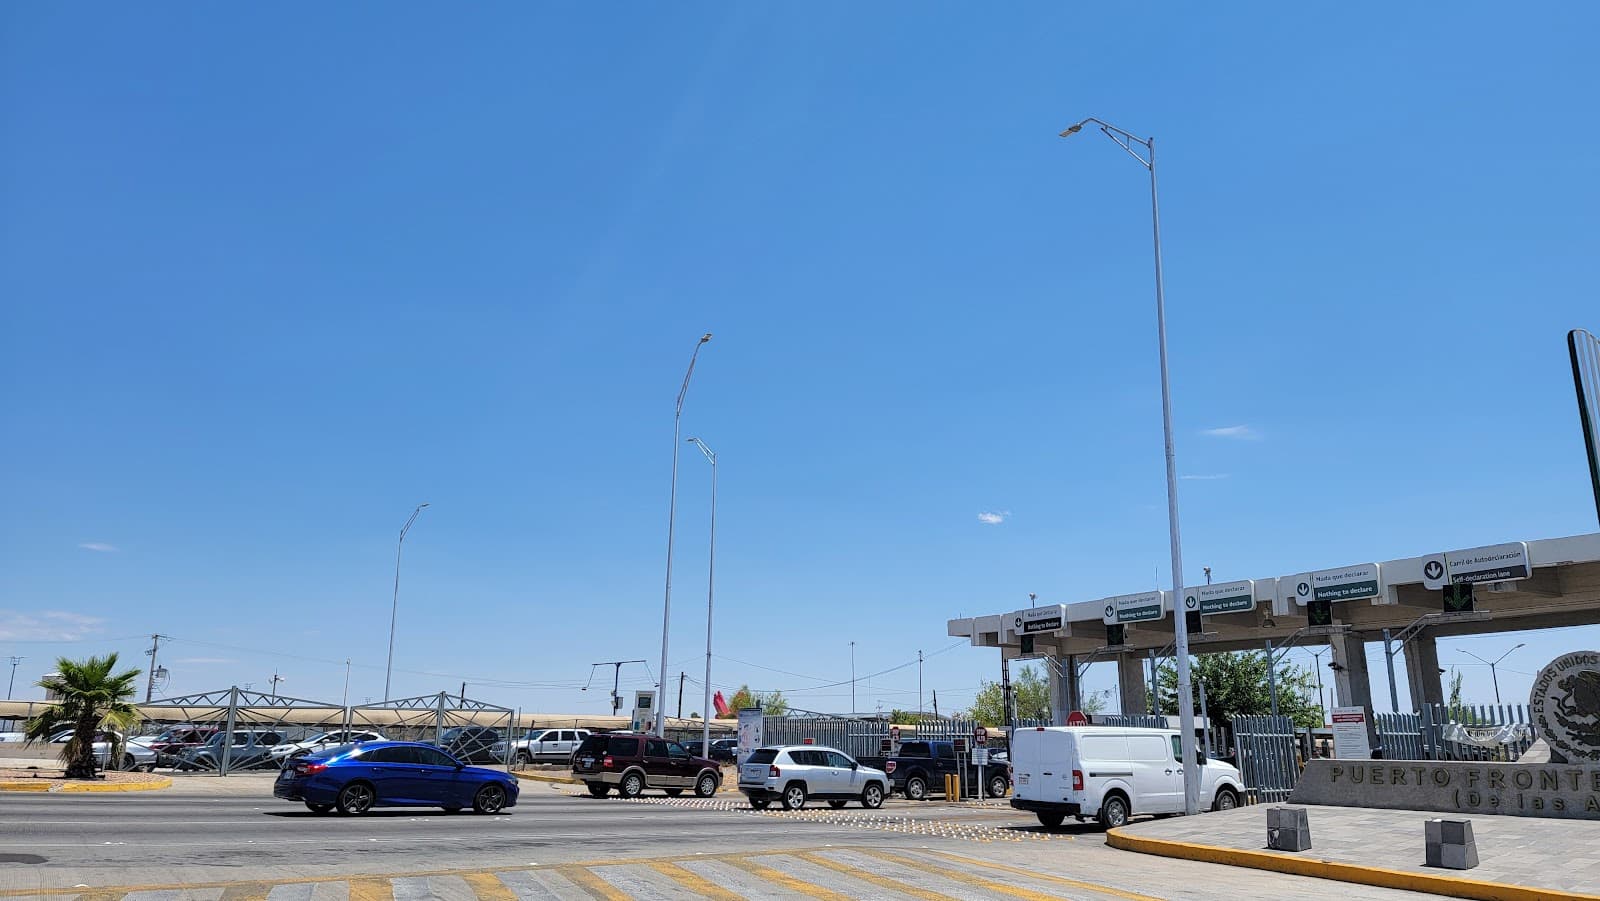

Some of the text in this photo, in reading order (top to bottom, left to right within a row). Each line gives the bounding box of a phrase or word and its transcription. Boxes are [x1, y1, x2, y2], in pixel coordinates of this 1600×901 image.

[1450, 559, 1465, 567] Carril
[1452, 570, 1511, 583] Self-declaration lane
[1317, 590, 1341, 598] Nothing
[1350, 586, 1373, 594] declare
[1534, 655, 1598, 713] ESTADOS UNIDOS
[1330, 765, 1451, 787] PUERTO
[1517, 793, 1565, 811] las
